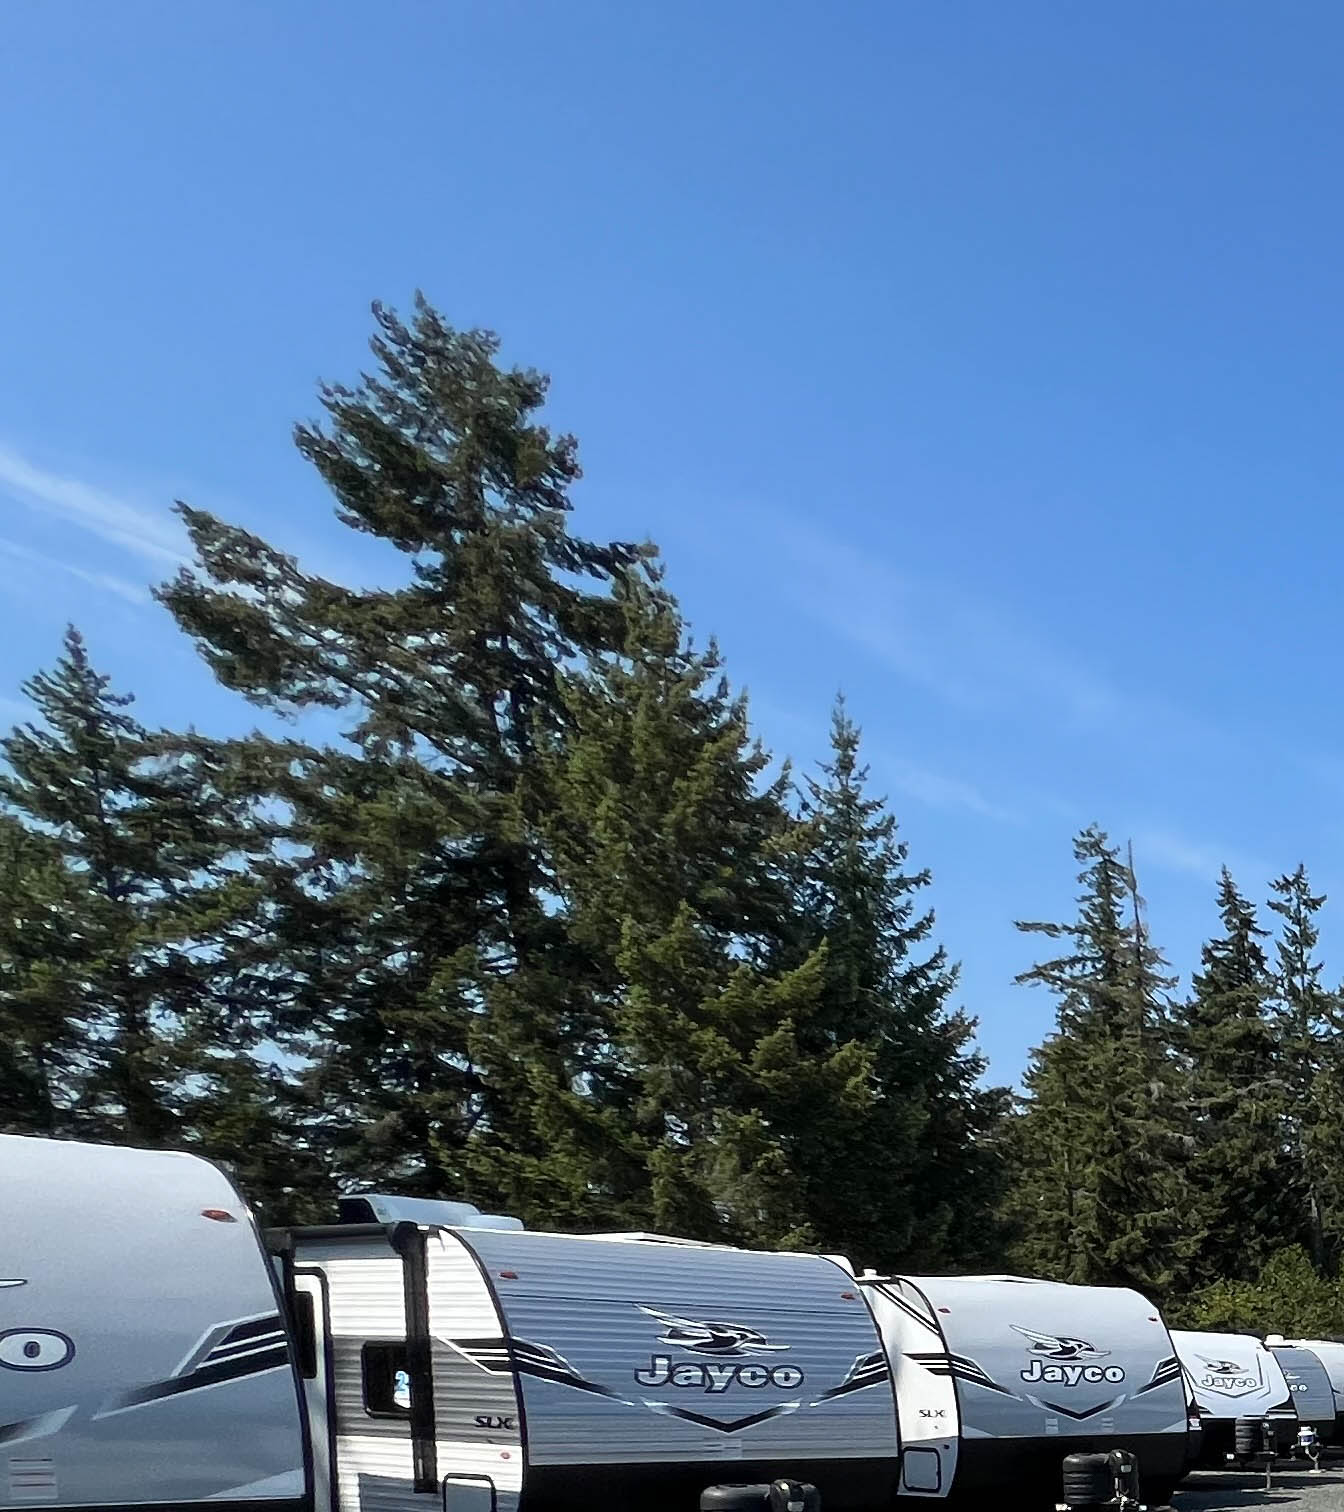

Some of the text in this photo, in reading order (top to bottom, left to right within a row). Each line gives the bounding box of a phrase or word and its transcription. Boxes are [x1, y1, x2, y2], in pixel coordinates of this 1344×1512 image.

[633, 1354, 804, 1393] Jayco
[1020, 1360, 1125, 1387] Jayco
[1201, 1374, 1257, 1389] Jayco
